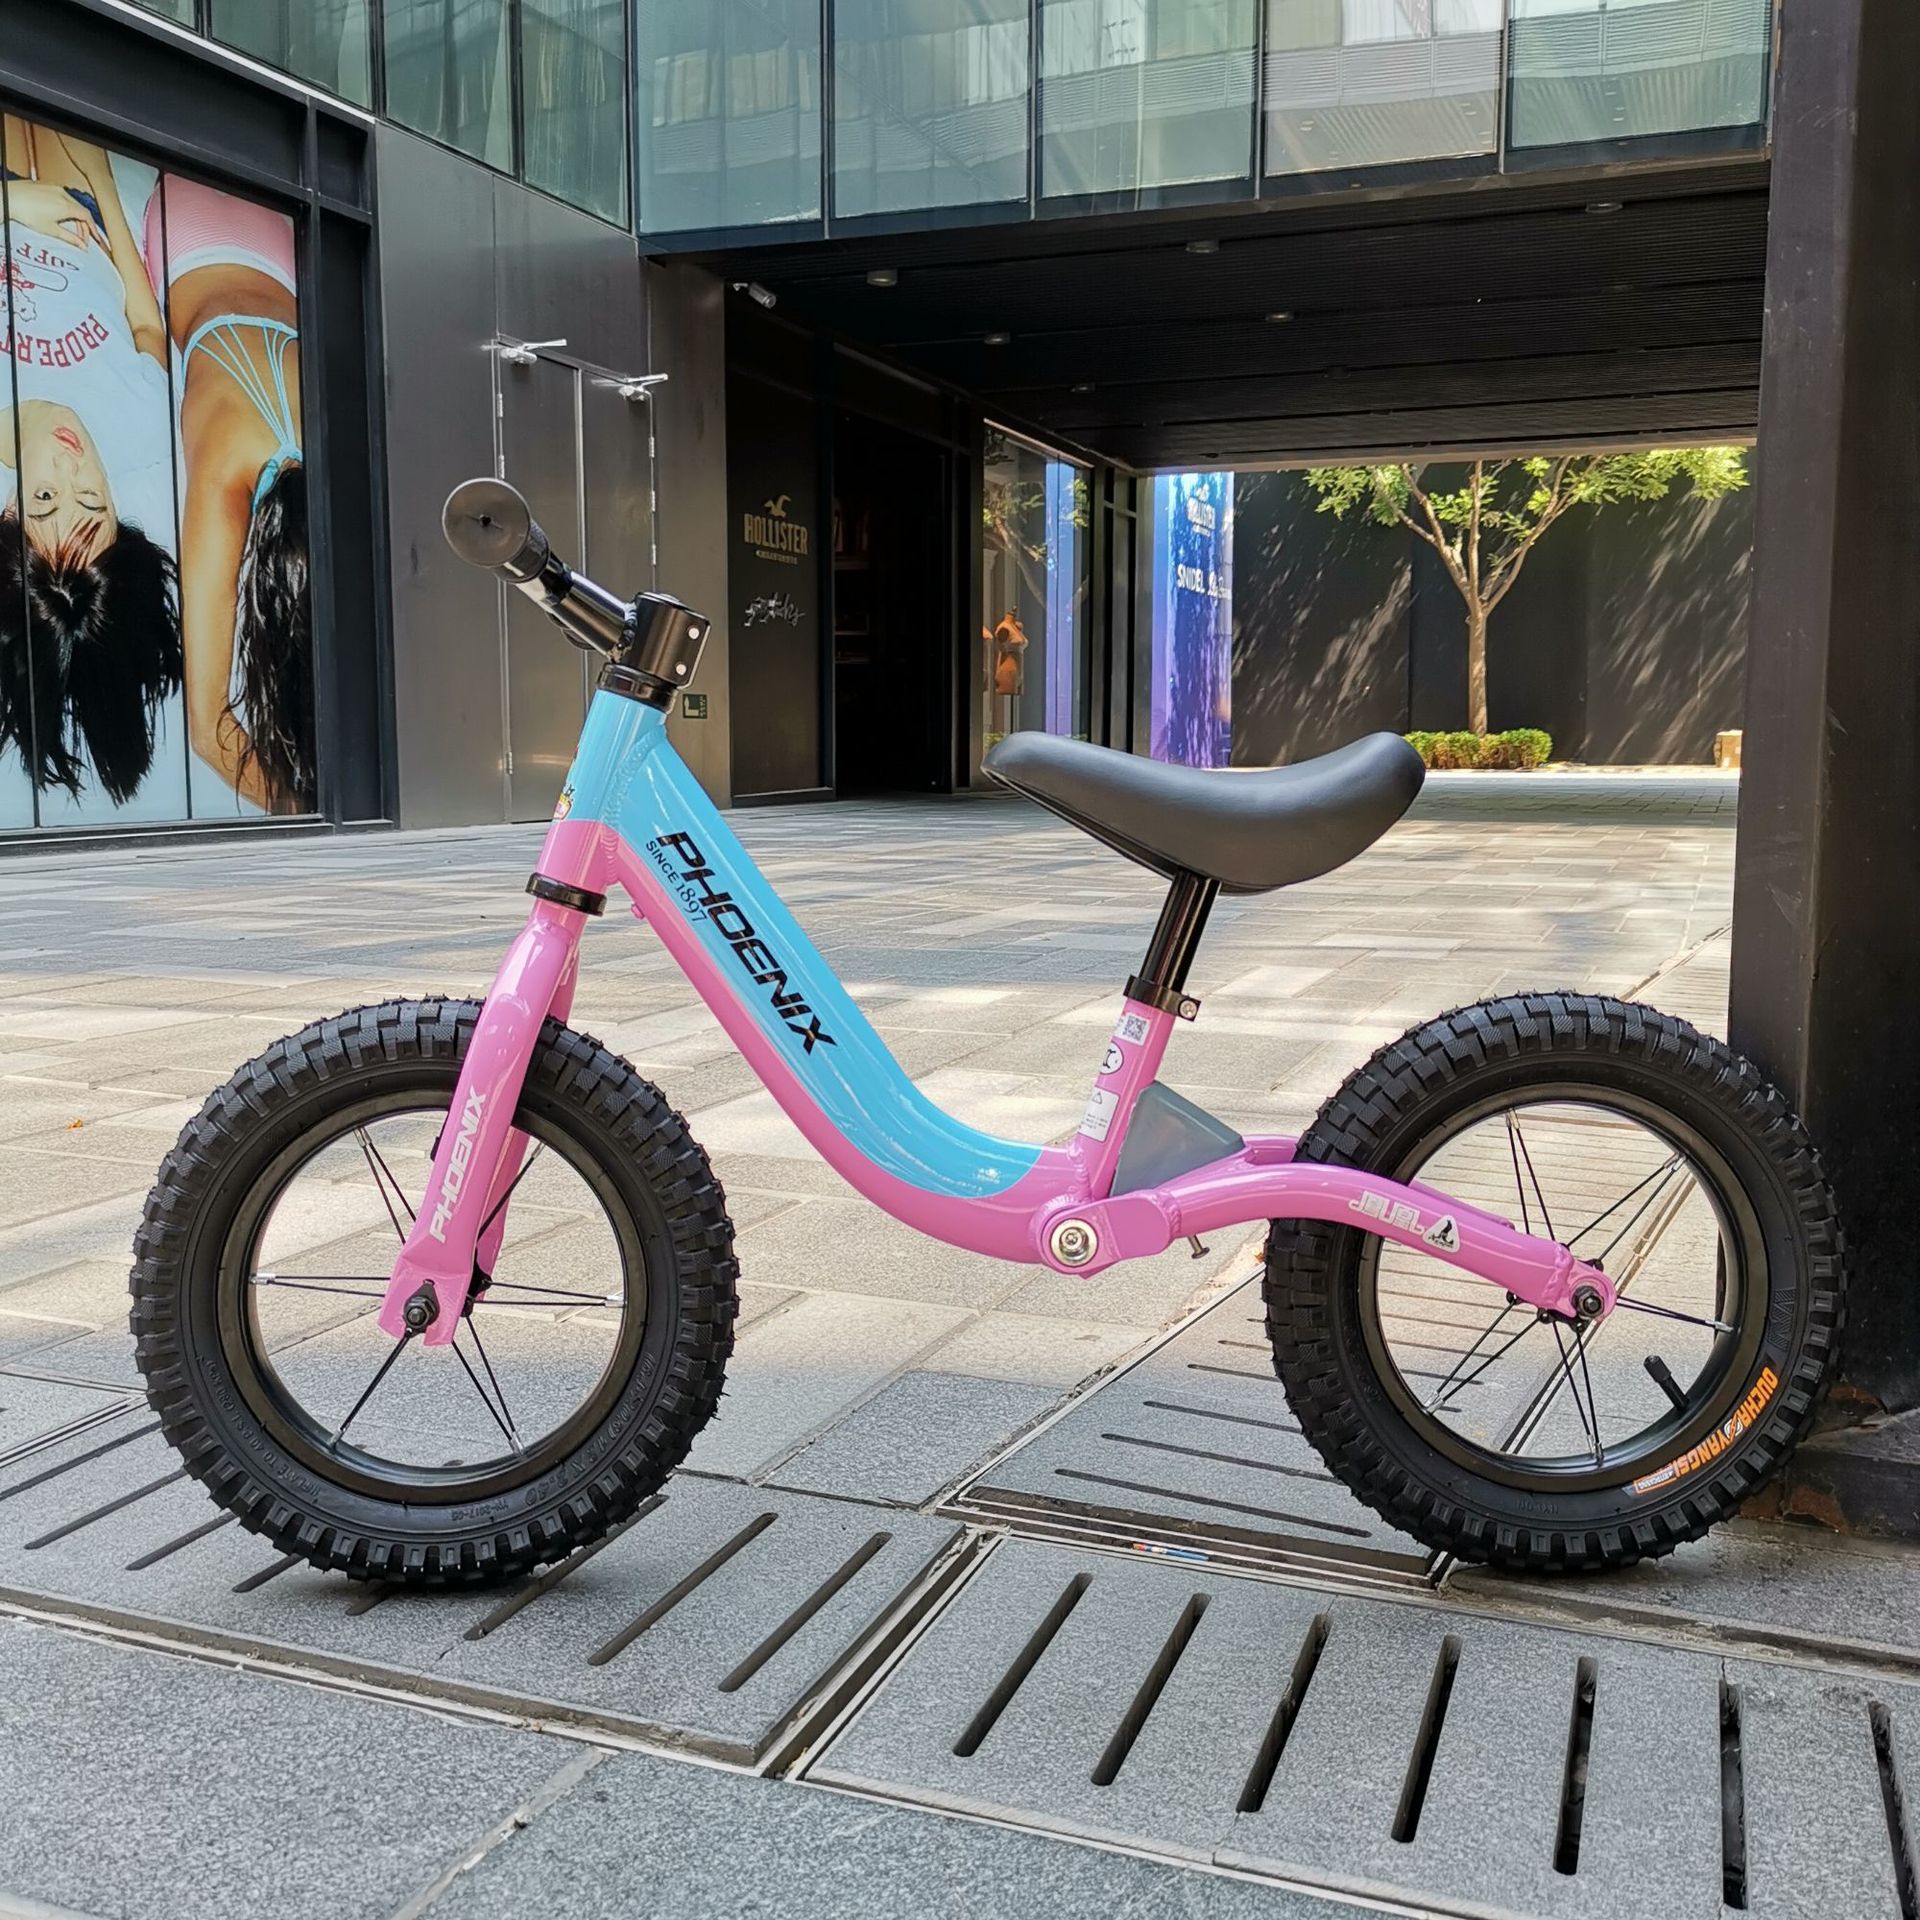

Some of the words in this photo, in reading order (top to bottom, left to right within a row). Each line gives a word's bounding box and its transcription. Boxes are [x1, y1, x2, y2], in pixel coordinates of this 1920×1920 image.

[744, 513, 808, 555] HOLLISTER
[645, 839, 680, 884] SINCE
[675, 881, 708, 923] 1897
[656, 831, 837, 1056] PHOENIX
[429, 1085, 487, 1244] PHOENIX
